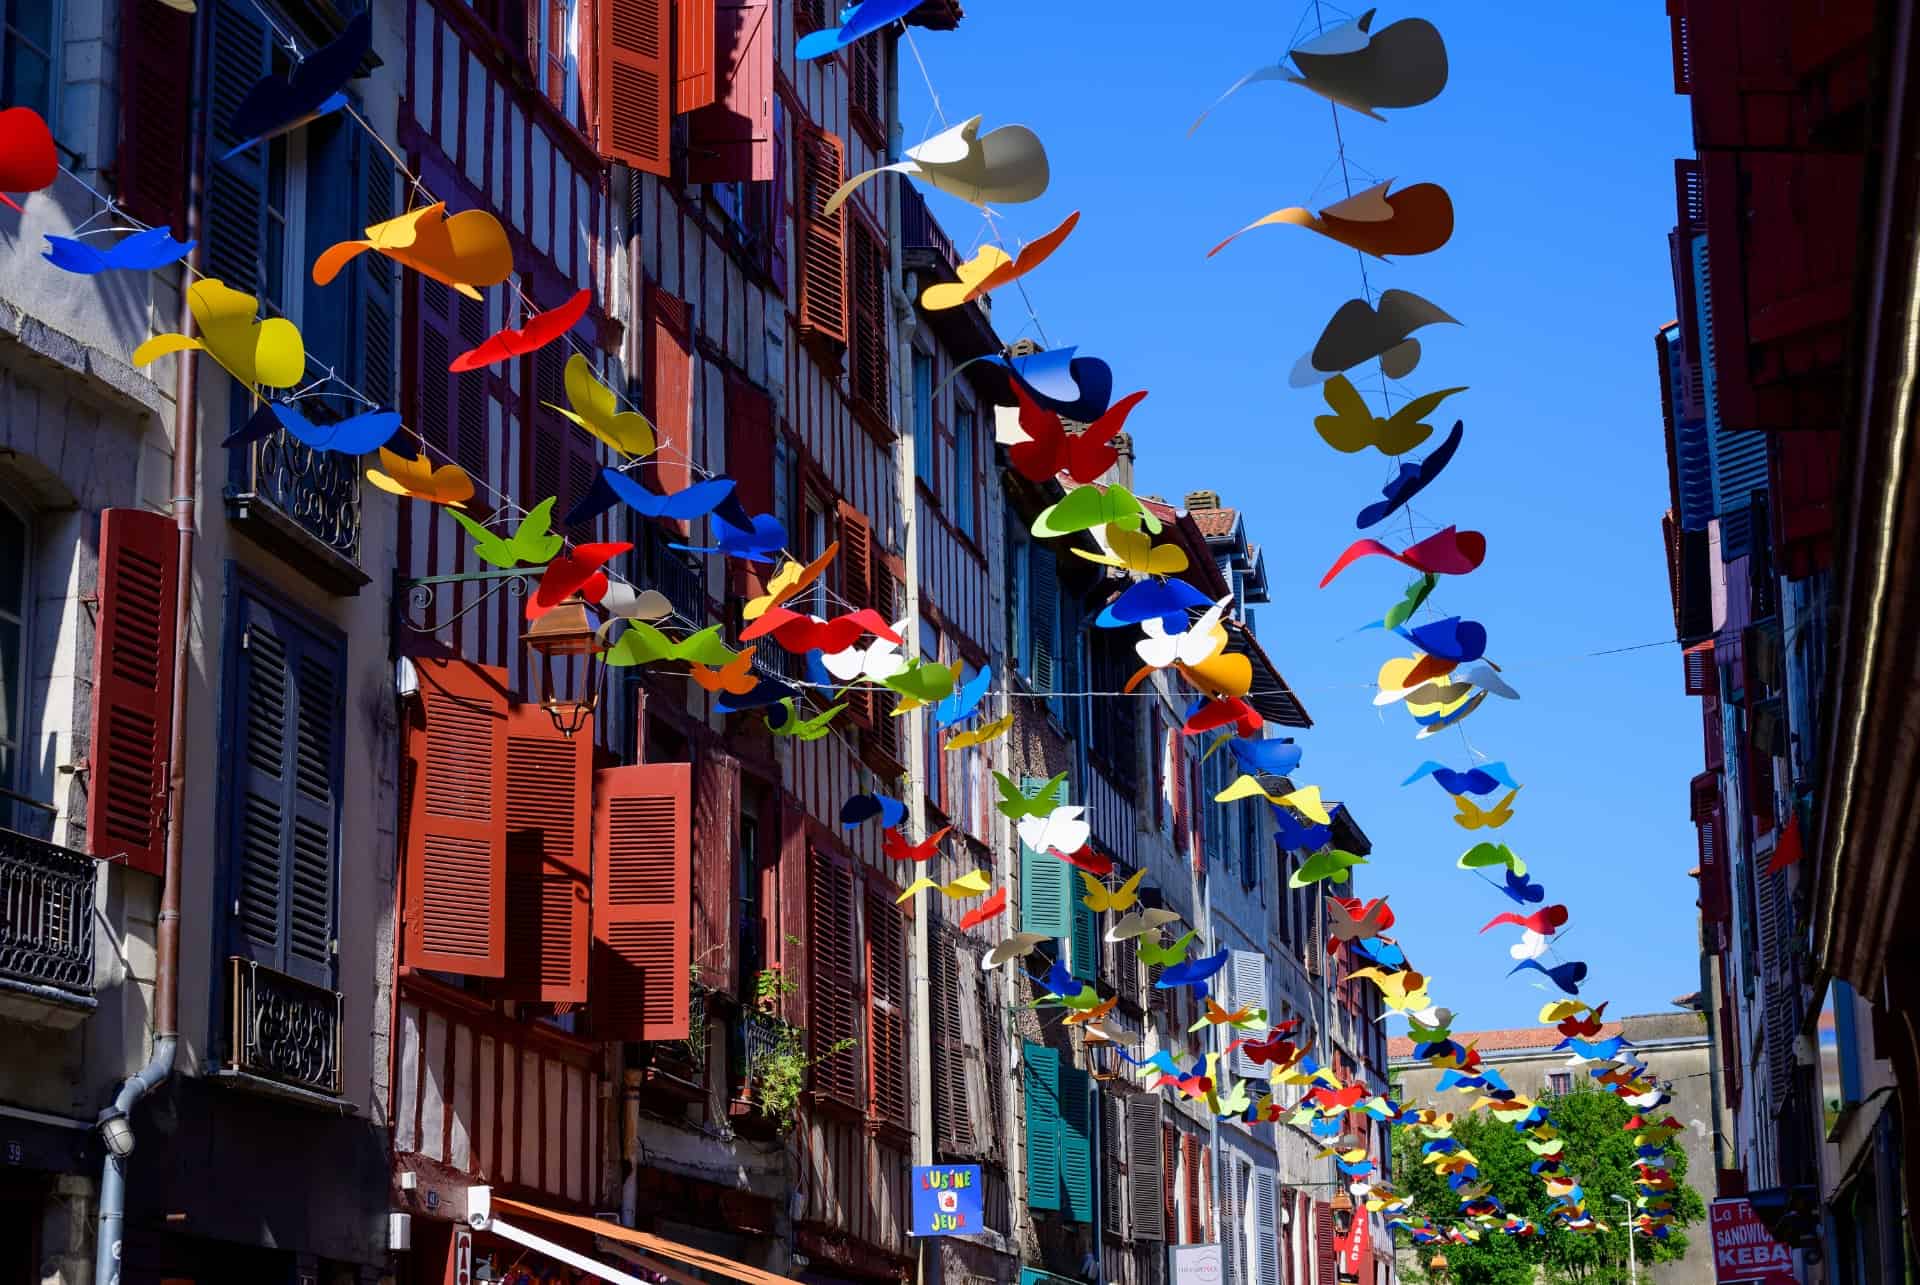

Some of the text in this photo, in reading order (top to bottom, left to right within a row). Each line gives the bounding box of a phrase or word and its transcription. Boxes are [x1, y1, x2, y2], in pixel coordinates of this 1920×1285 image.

[1351, 1218, 1364, 1261] TABAC
[1716, 1223, 1774, 1248] SANDWIC
[1718, 1243, 1793, 1267] KEBA
